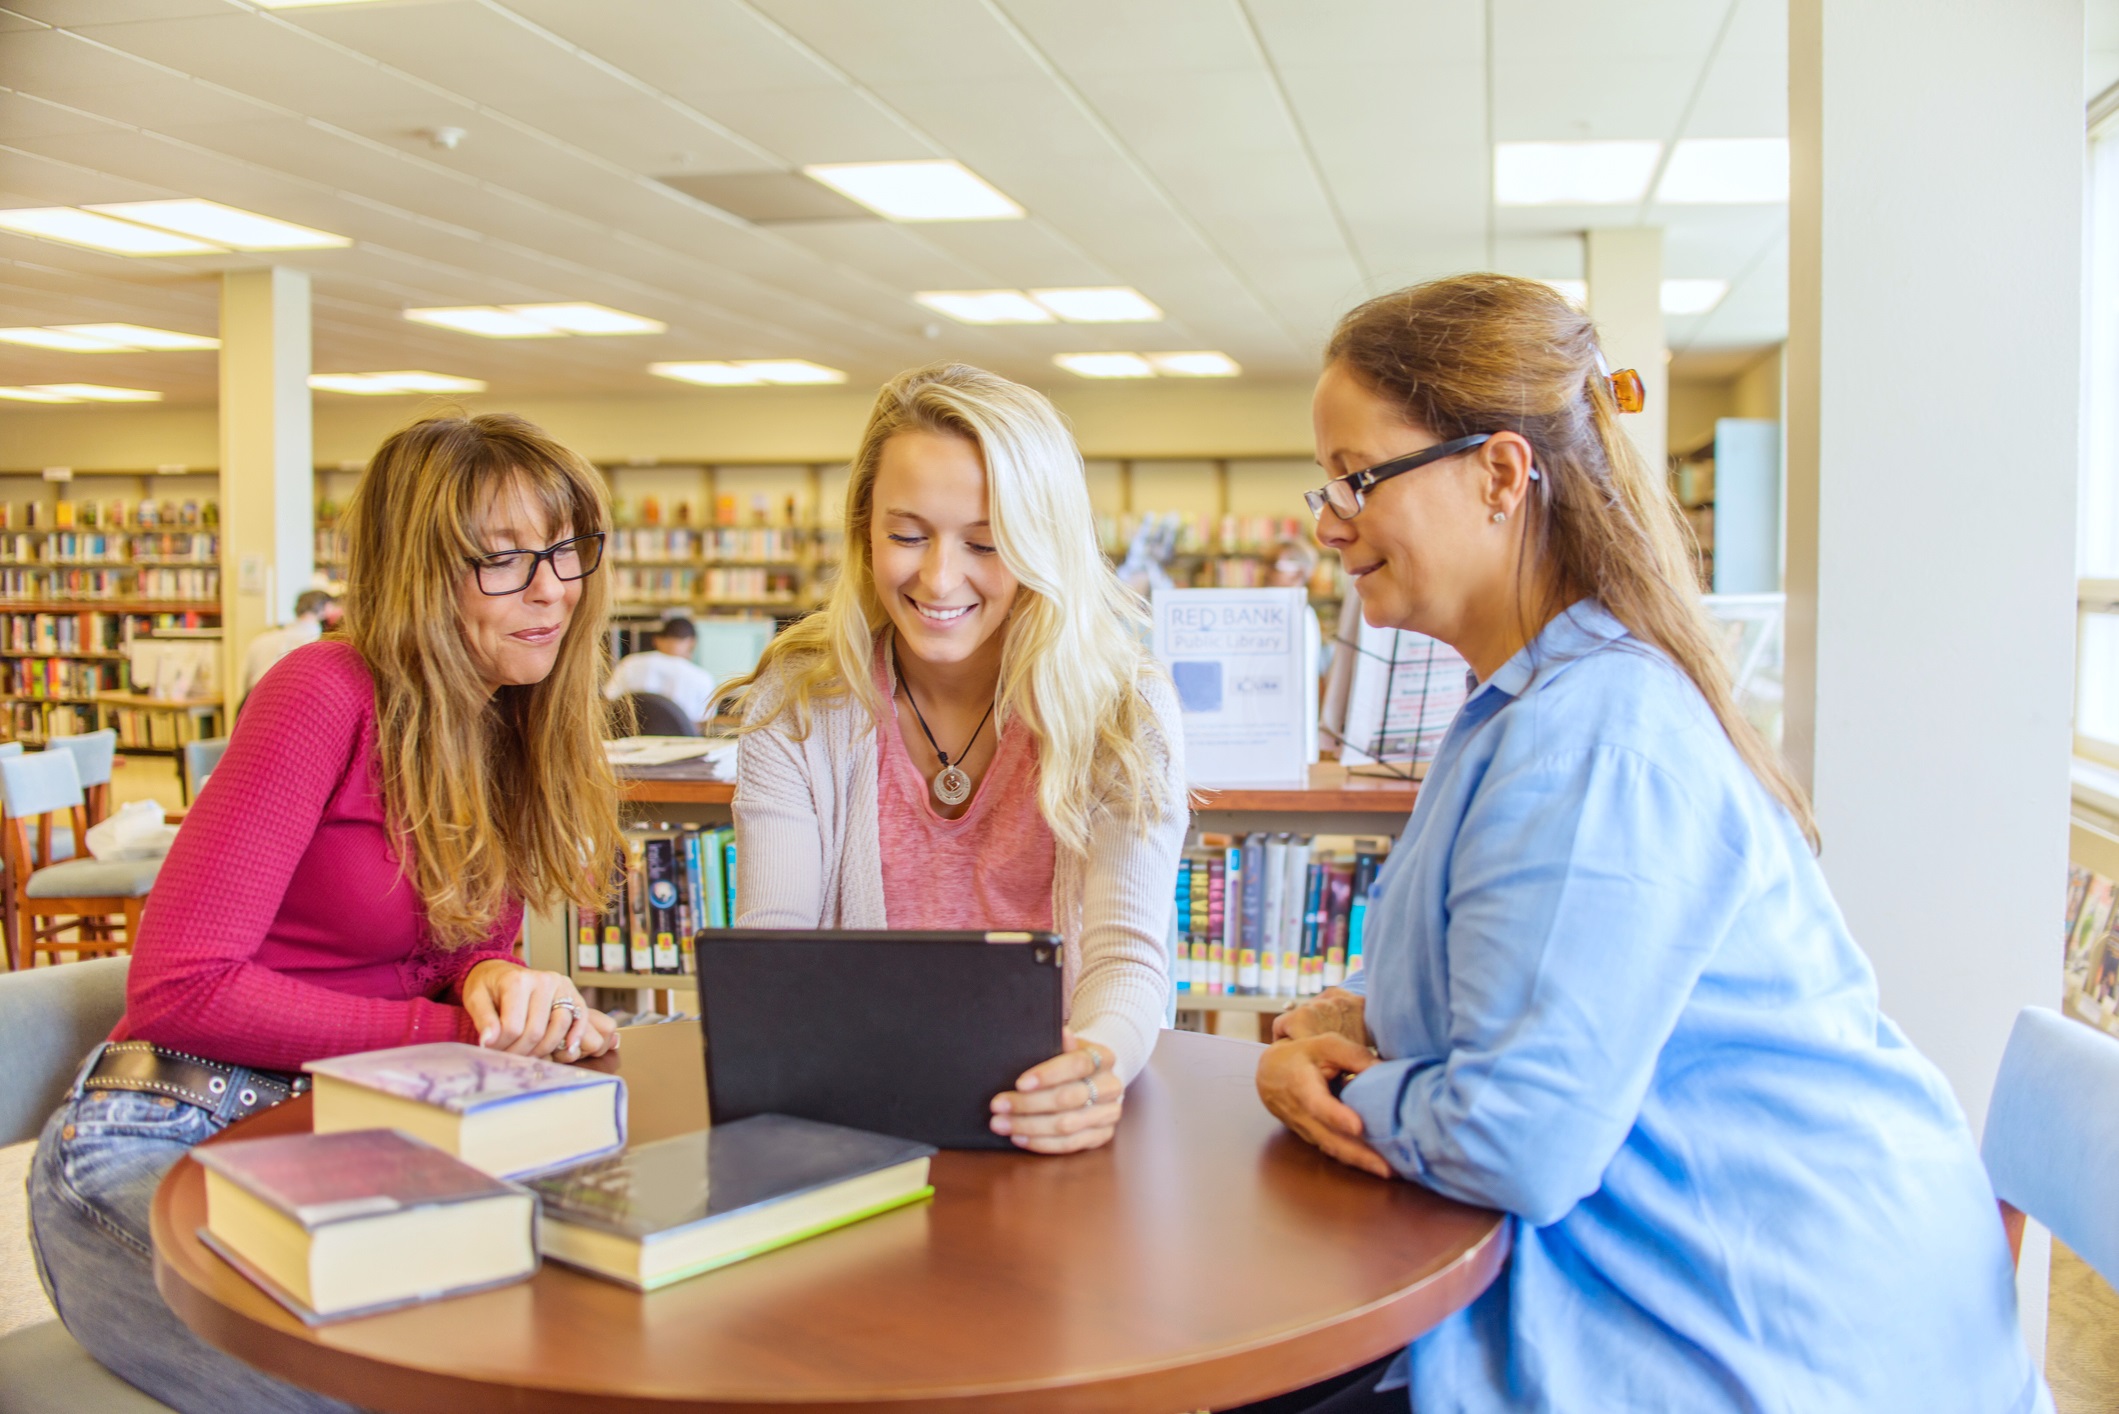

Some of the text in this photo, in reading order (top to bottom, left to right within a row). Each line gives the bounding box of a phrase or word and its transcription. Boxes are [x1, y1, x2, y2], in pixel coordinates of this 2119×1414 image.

[1171, 607, 1284, 628] RED BANK
[1174, 634, 1281, 652] Public Library
